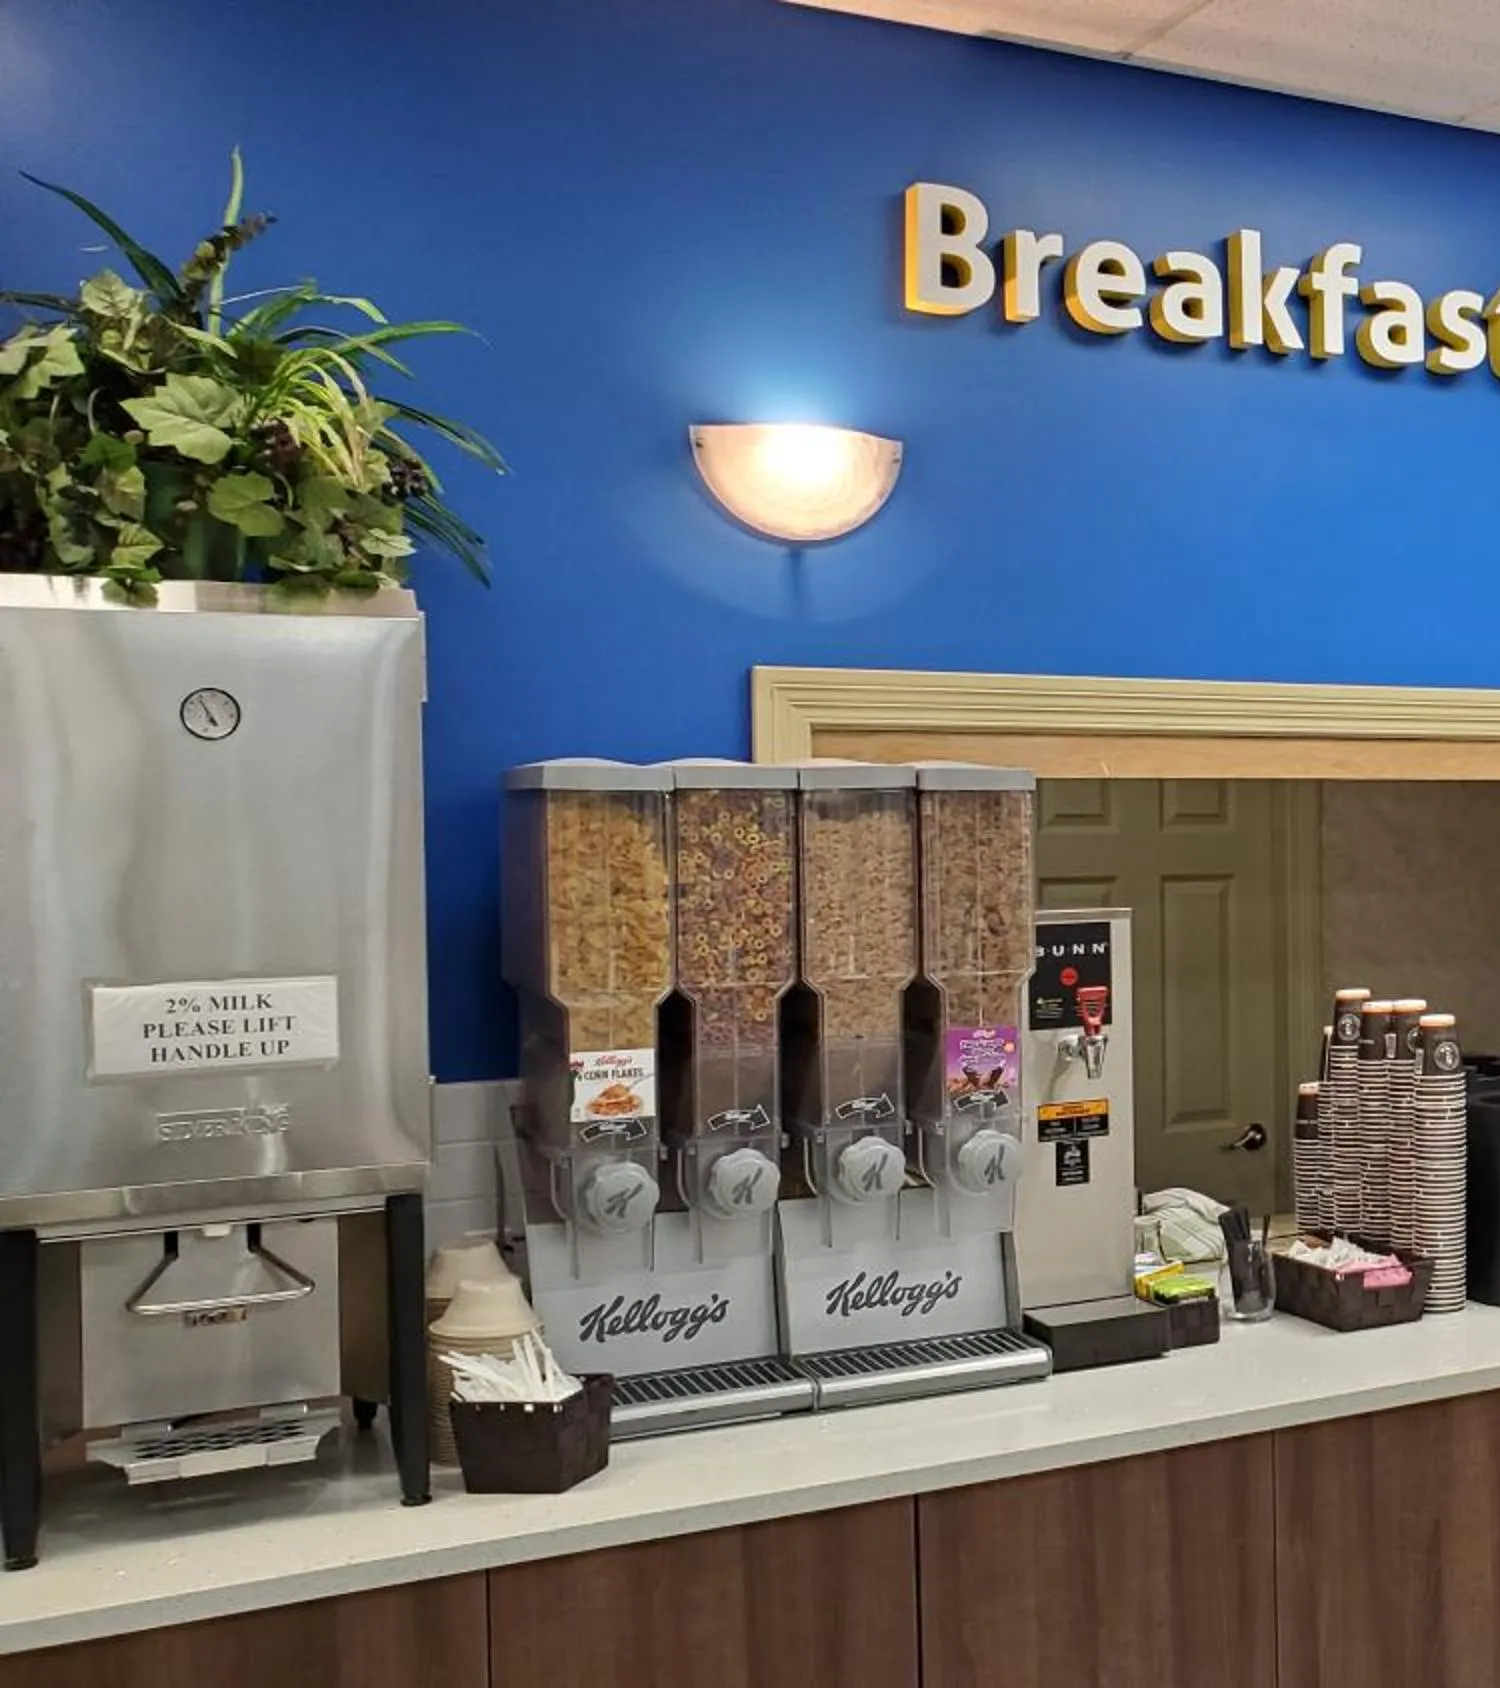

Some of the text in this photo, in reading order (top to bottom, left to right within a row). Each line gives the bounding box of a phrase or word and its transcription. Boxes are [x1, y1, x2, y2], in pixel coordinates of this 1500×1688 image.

[165, 993, 273, 1014] 2% MILK
[142, 1016, 297, 1039] PLEASE LIFT
[151, 1040, 290, 1063] HANDLE UP
[826, 1270, 963, 1317] Kellogg's
[579, 1293, 730, 1343] Kellogg's
